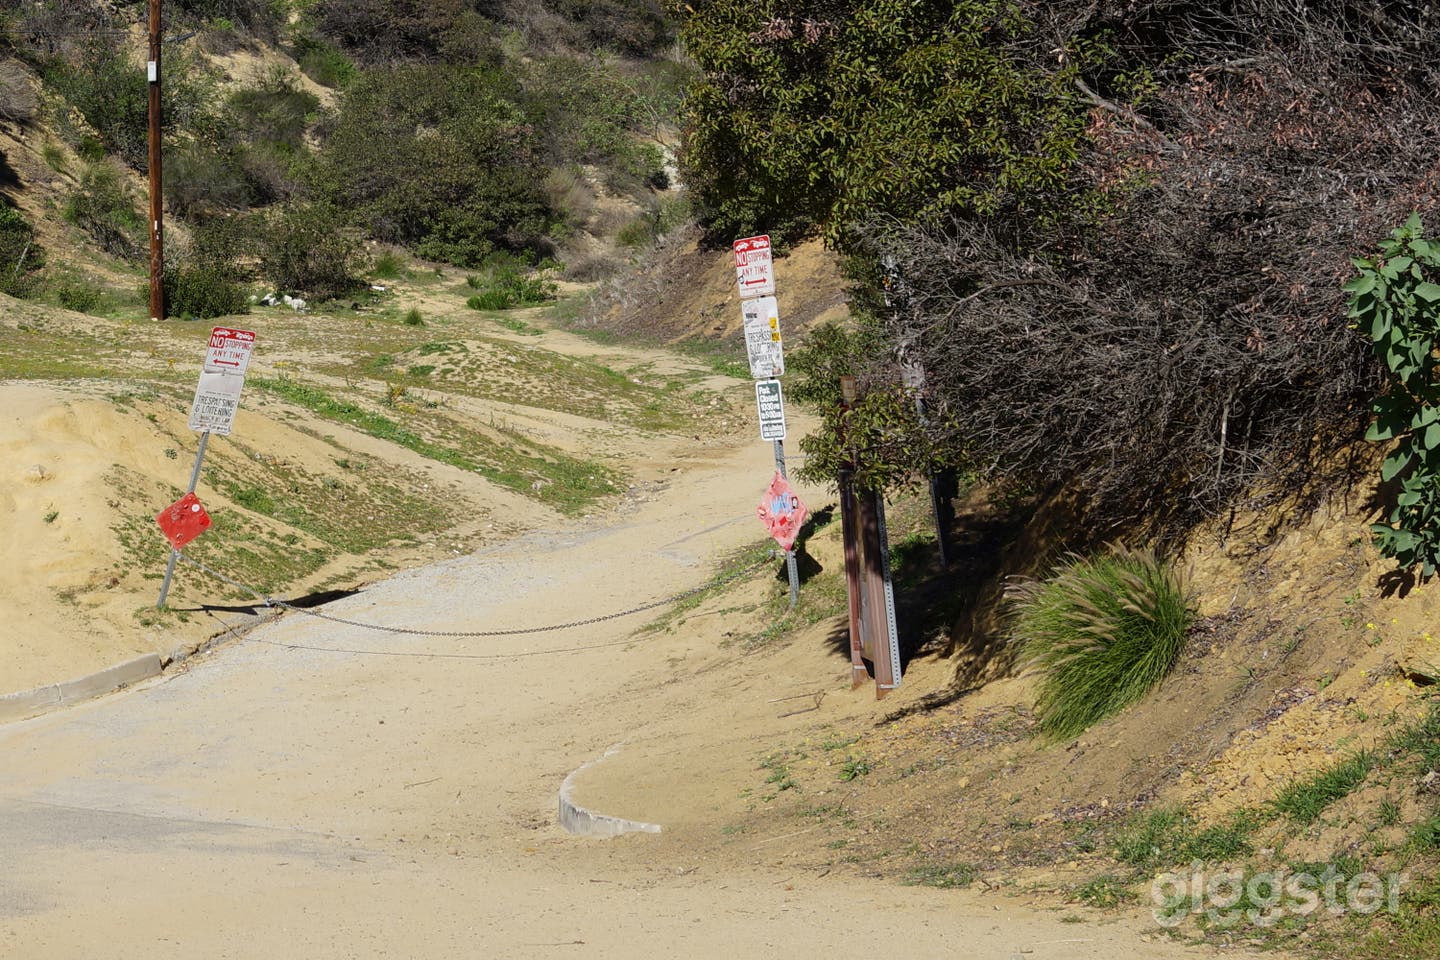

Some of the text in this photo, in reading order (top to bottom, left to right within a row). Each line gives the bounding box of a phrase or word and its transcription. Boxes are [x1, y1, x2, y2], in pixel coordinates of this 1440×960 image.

[735, 250, 770, 266] NO STOPPING
[742, 265, 768, 277] ANY TIME
[211, 335, 252, 351] NO STOPPING
[213, 350, 245, 360] ANY TIME
[759, 386, 771, 394] Park
[760, 393, 779, 402] Closed
[201, 405, 233, 417] LOITERING
